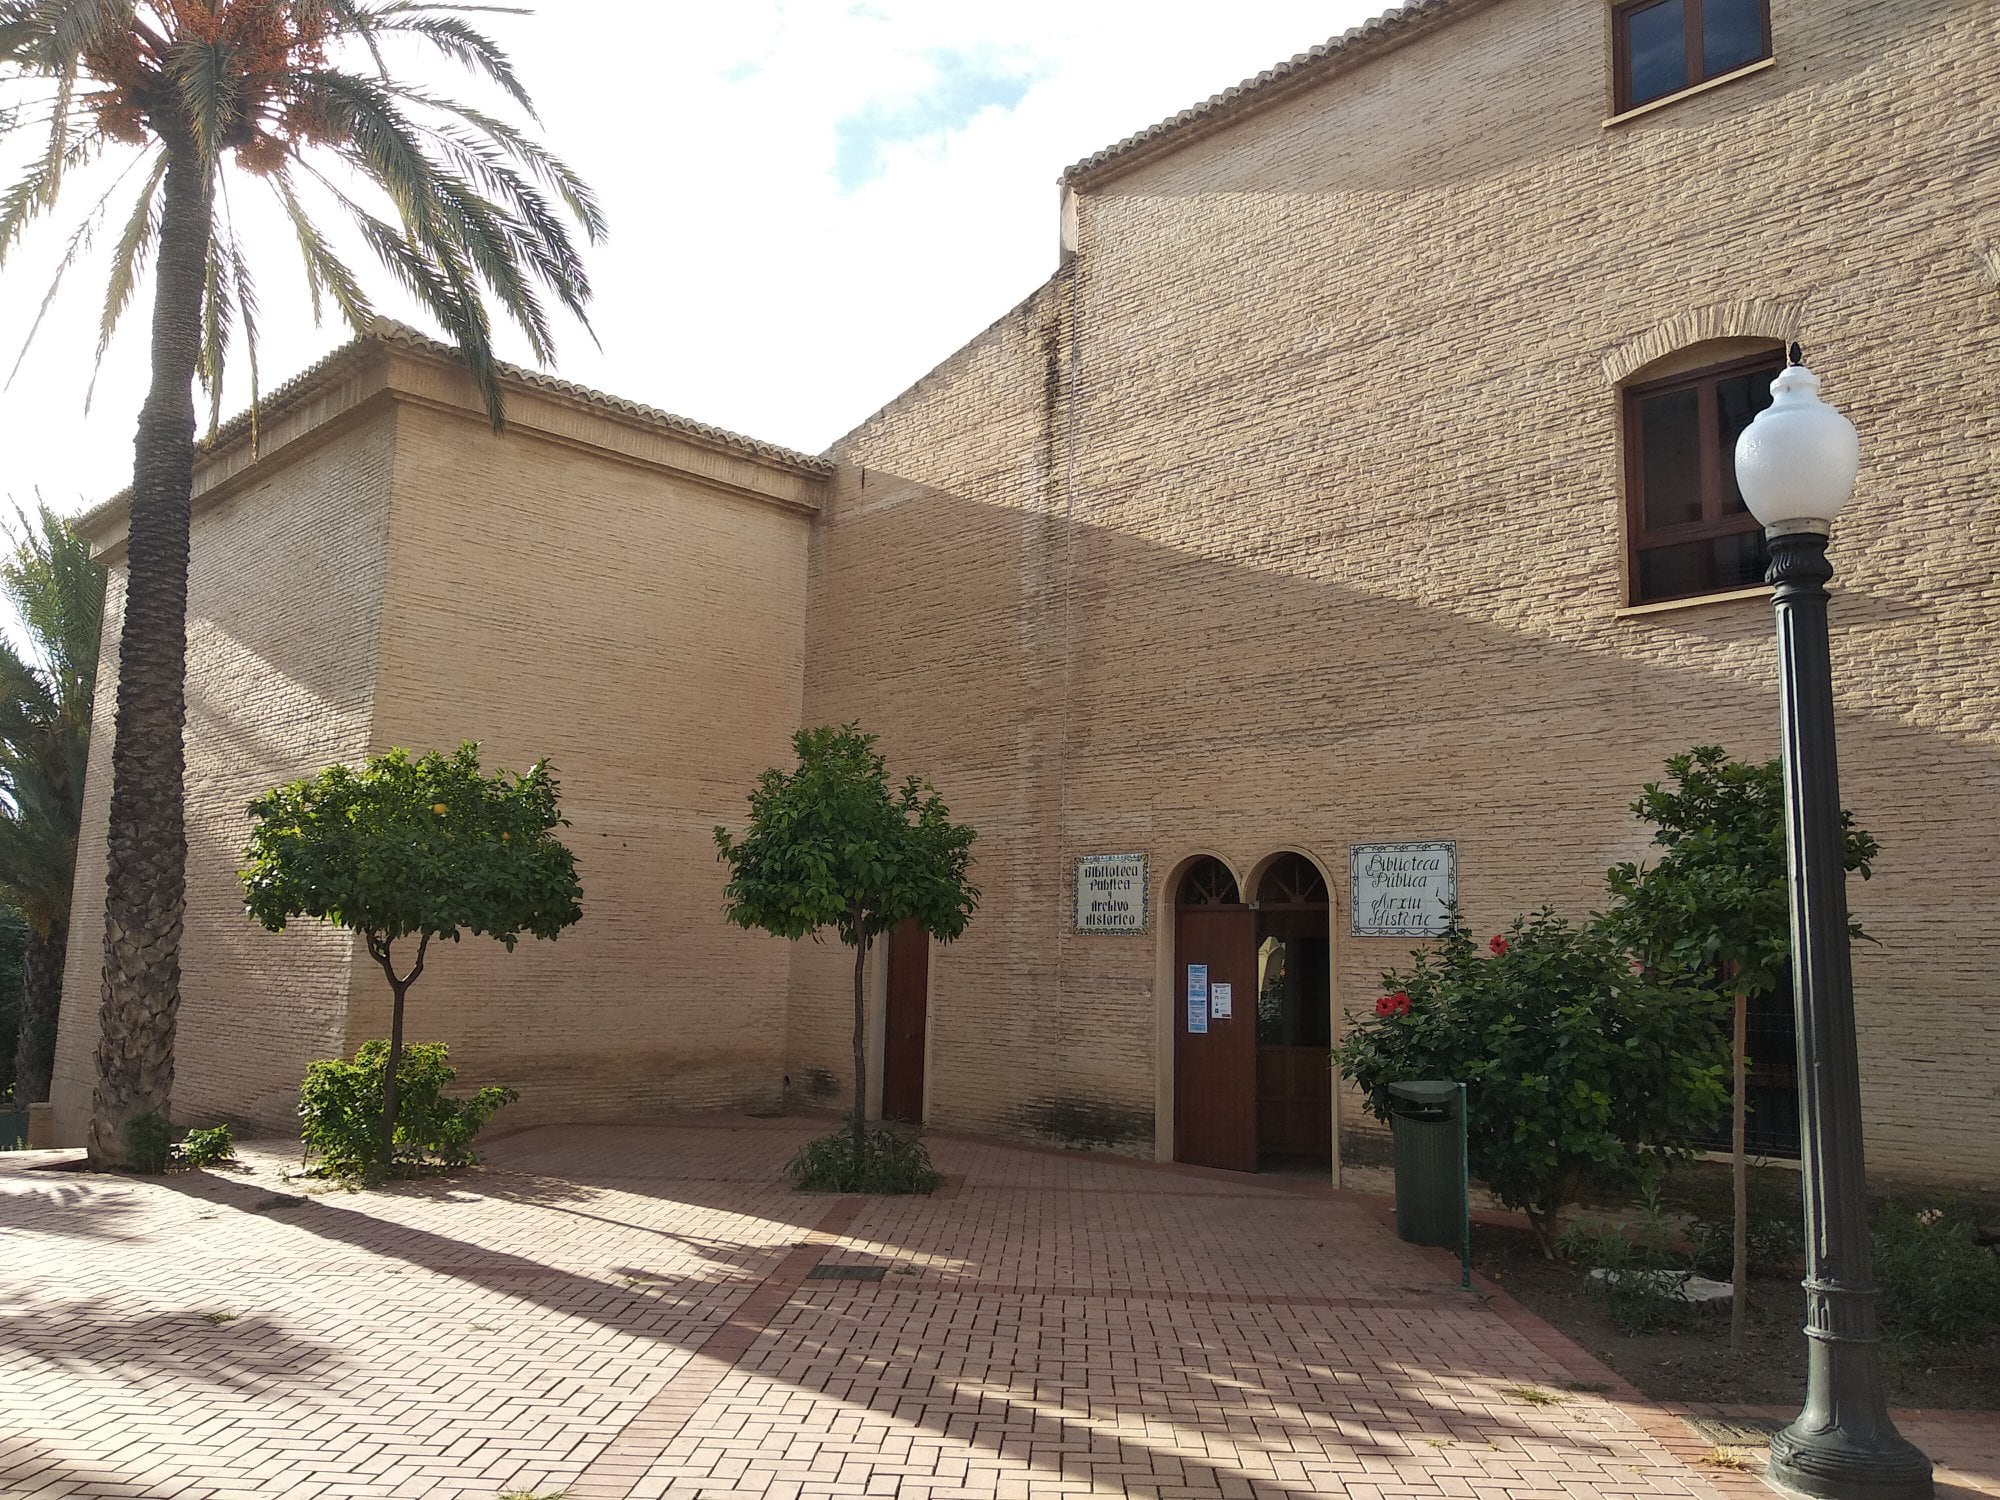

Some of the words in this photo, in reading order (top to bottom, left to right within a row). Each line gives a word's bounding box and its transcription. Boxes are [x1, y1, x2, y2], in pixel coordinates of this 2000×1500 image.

[1084, 865, 1138, 878] Biblioteca
[1366, 854, 1440, 876] Biblioteca
[1091, 900, 1129, 912] Archivo
[1371, 892, 1422, 913] Arxiu
